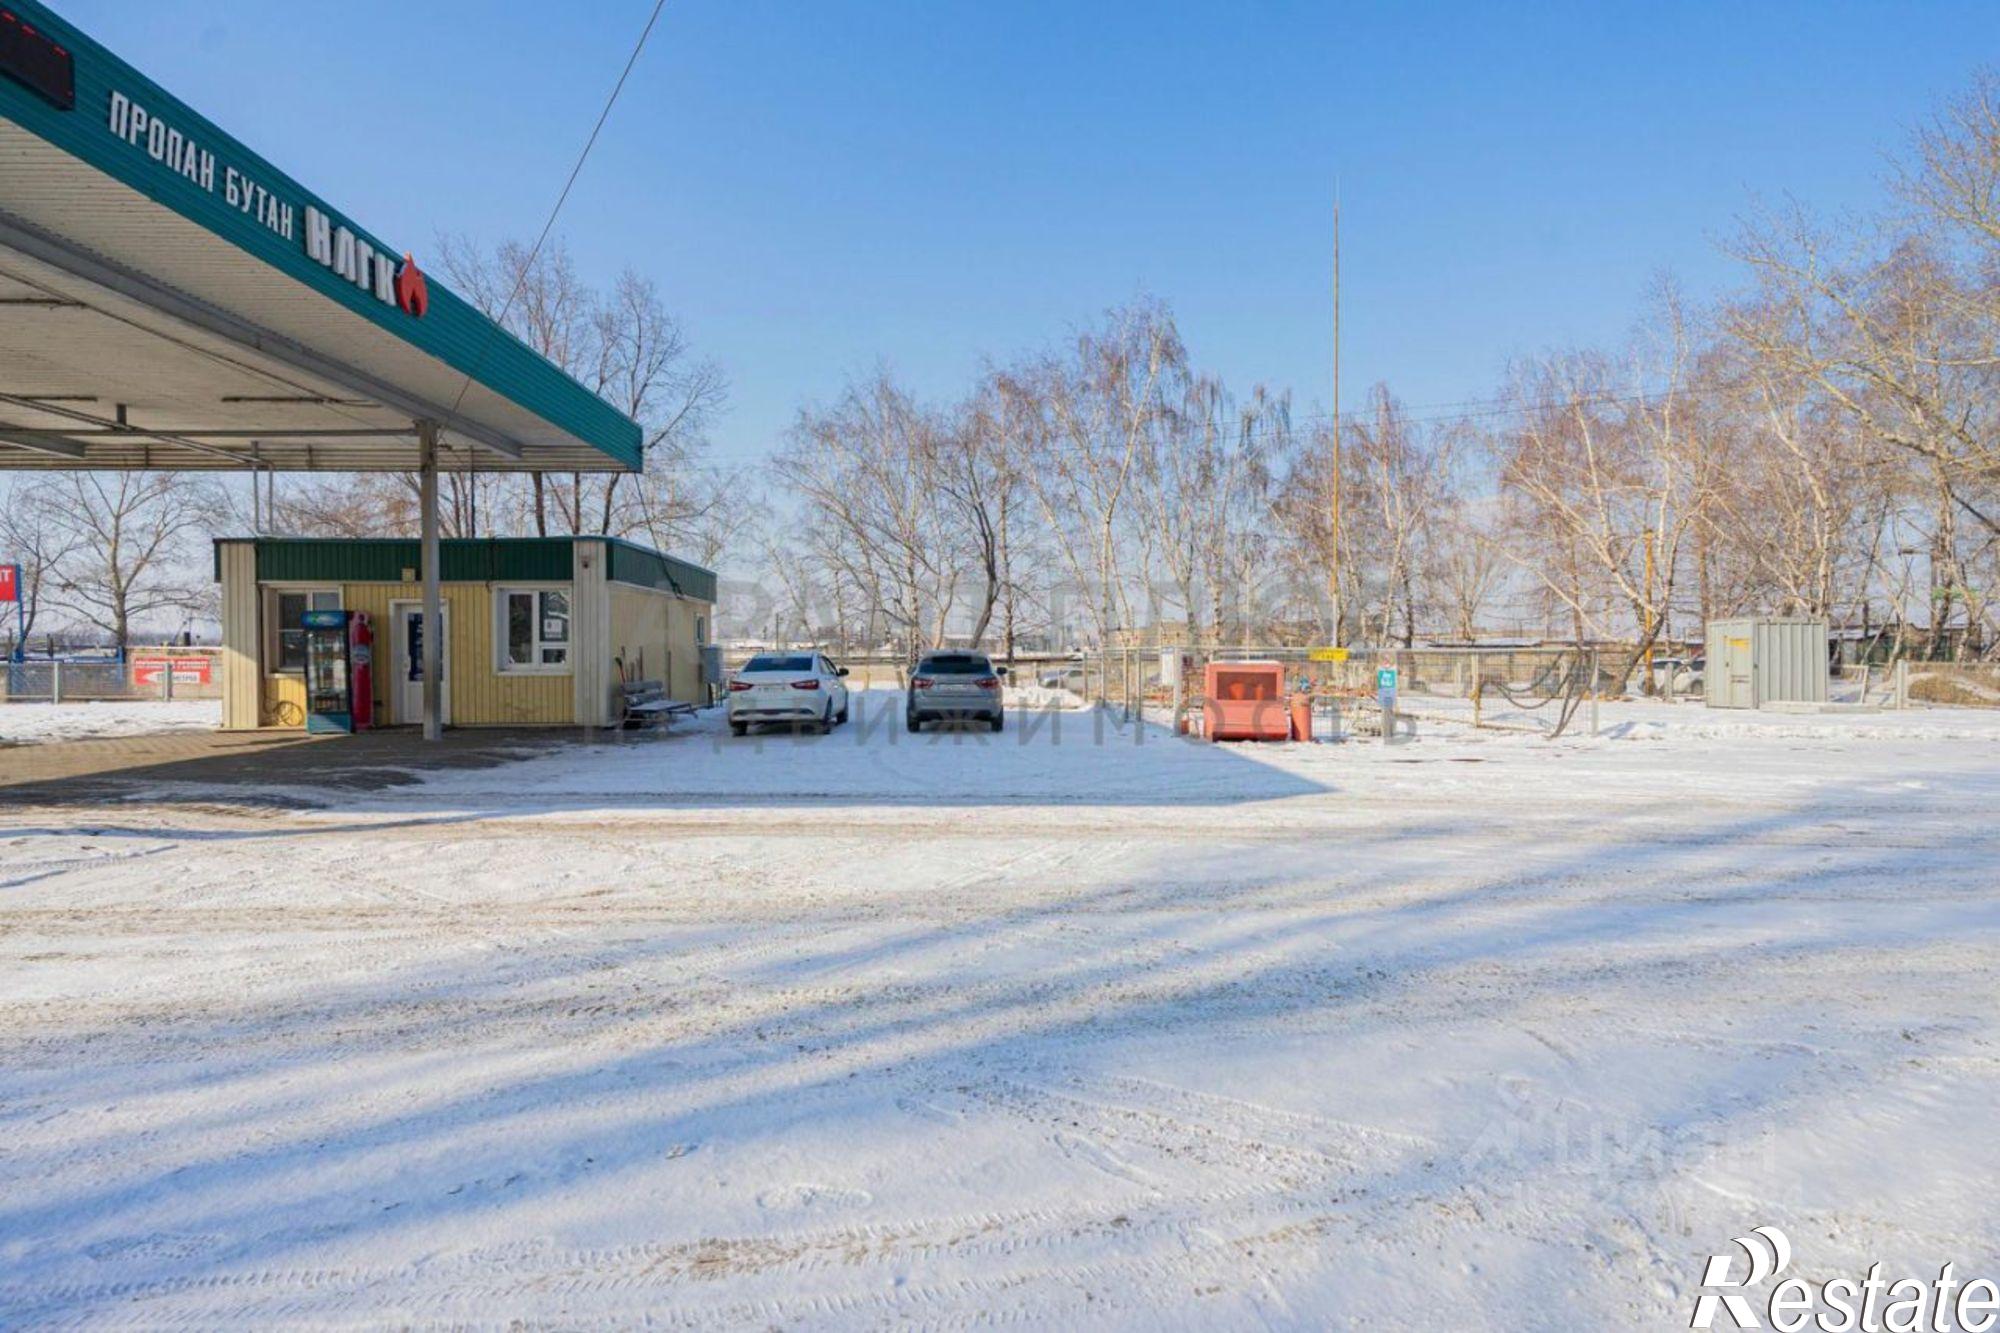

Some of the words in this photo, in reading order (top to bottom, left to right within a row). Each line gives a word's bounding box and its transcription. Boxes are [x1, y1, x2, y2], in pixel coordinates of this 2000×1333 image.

[109, 90, 215, 193] ПРОПАН
[226, 166, 293, 240] БУТАН
[305, 205, 397, 307] НЛГК
